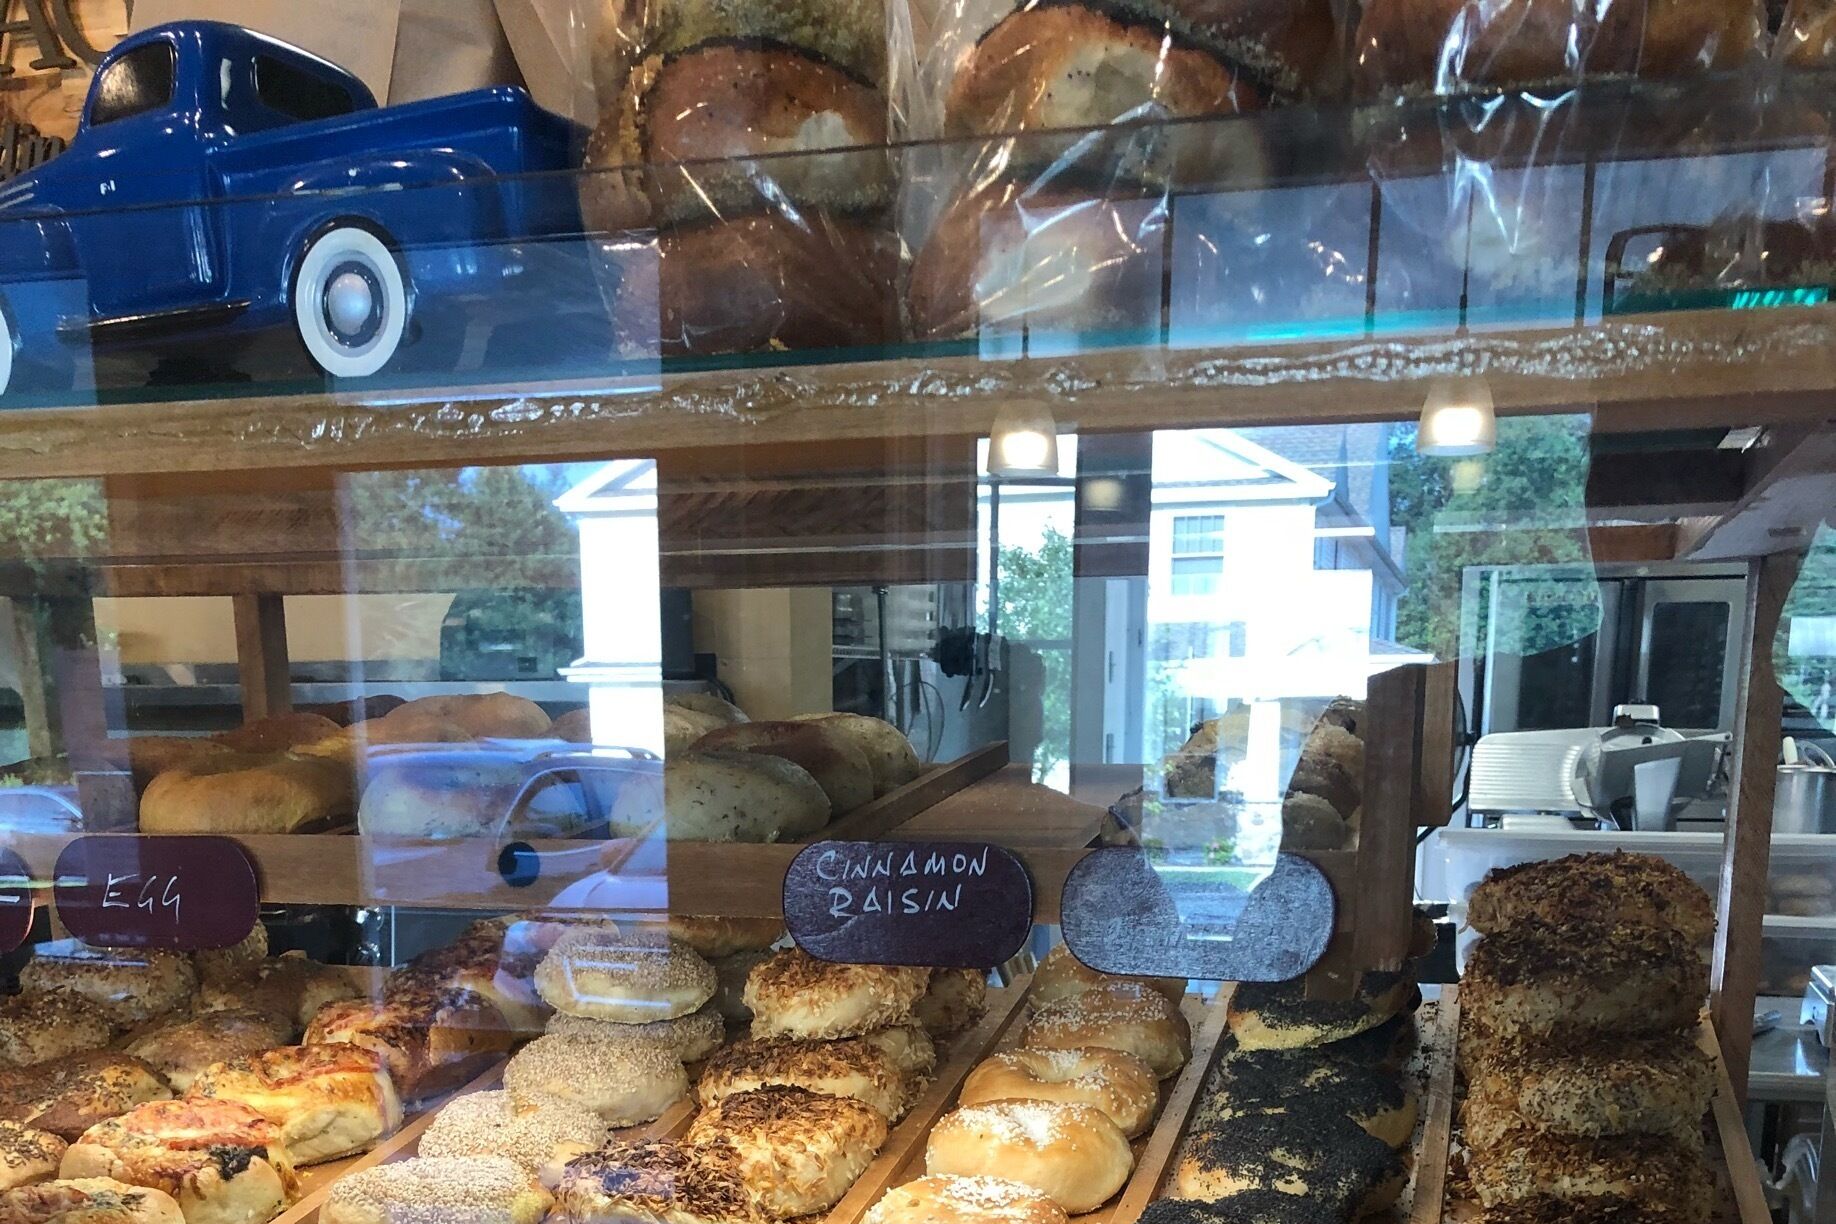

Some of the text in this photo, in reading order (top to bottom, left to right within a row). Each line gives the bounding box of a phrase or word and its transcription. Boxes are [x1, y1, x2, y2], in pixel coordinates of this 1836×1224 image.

[816, 846, 988, 880] CINNAMON
[102, 872, 182, 924] EGG
[828, 883, 962, 918] RAISIN
